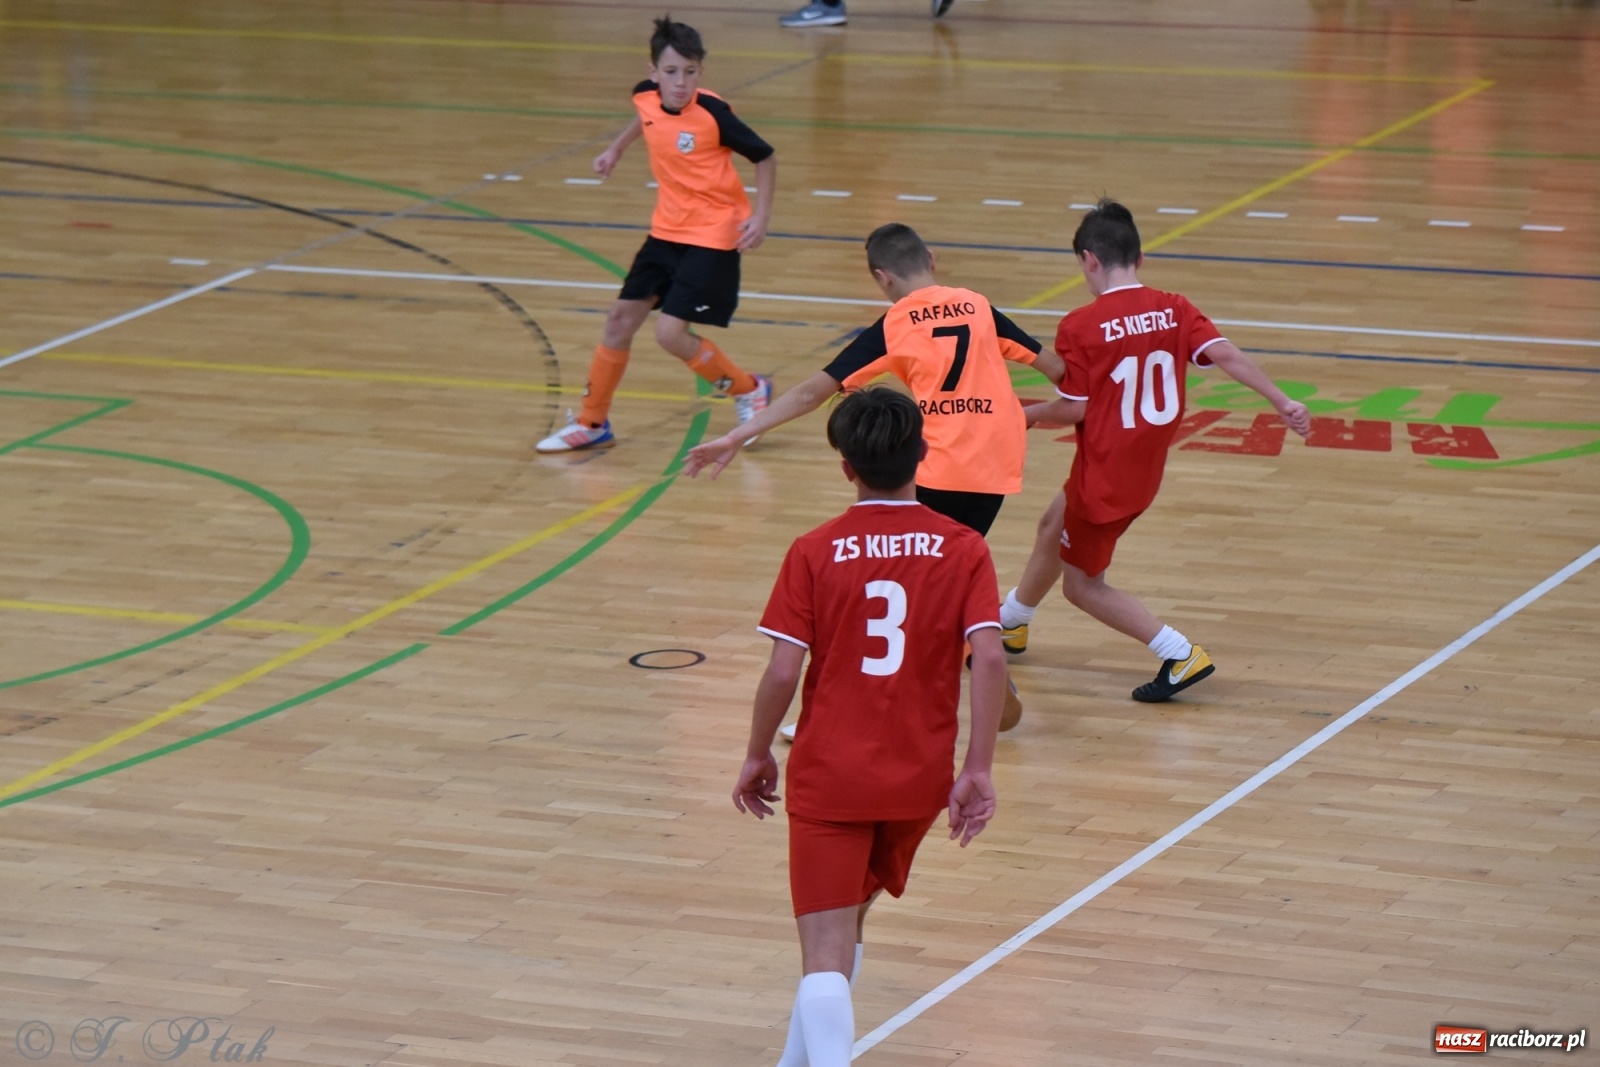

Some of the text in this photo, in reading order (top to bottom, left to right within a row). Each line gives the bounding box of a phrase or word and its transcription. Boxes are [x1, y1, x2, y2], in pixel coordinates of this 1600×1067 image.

[909, 302, 975, 325] RAFAKO
[1100, 308, 1178, 342] ZS KIETRZ
[931, 324, 971, 392] 7
[1109, 349, 1180, 429] 10
[832, 532, 945, 563] ZS KIETRZ
[861, 580, 908, 676] 3
